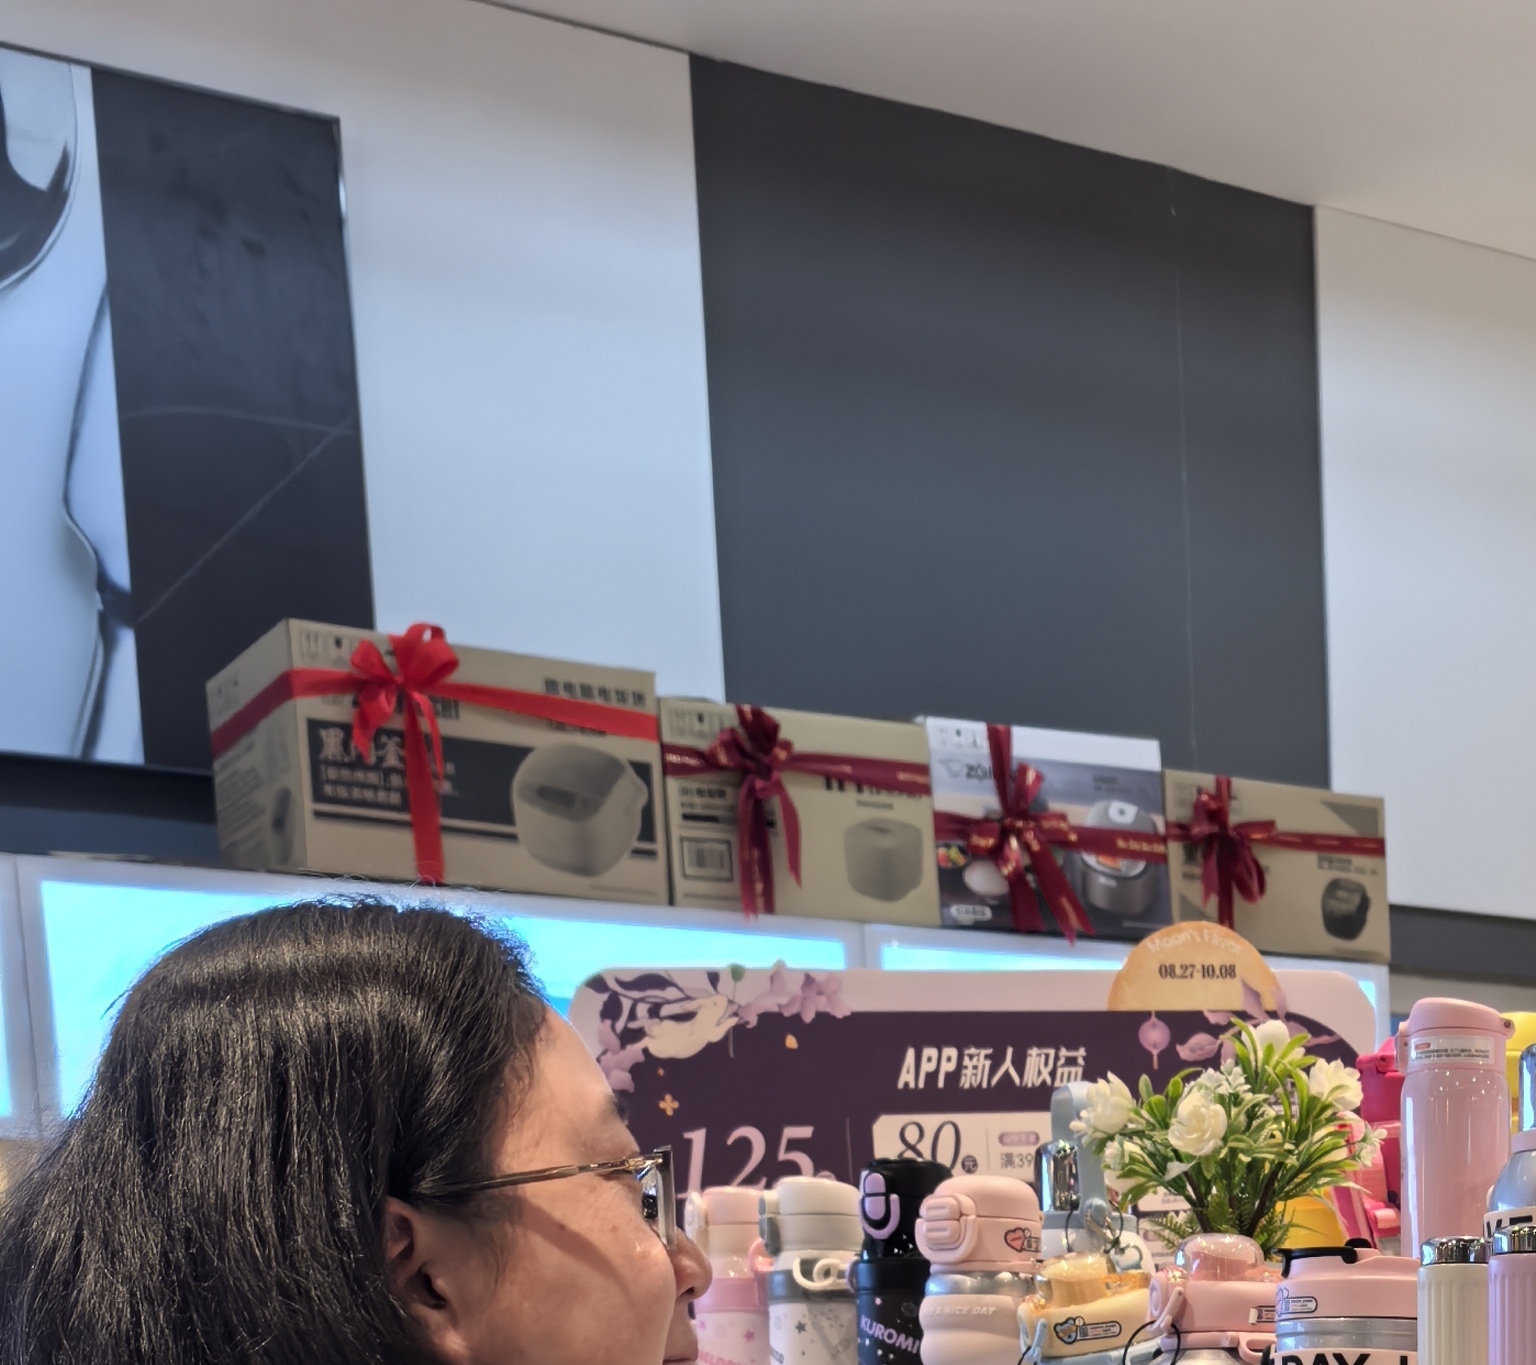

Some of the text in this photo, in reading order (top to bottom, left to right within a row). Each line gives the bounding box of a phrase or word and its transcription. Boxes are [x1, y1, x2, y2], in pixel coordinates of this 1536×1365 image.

[1147, 927, 1244, 957] Moon's Favor
[1158, 963, 1237, 981] 08.27-10.08
[898, 1046, 1087, 1090] APP新人权益
[898, 1120, 962, 1176] 80
[859, 1314, 920, 1356] KUROMI
